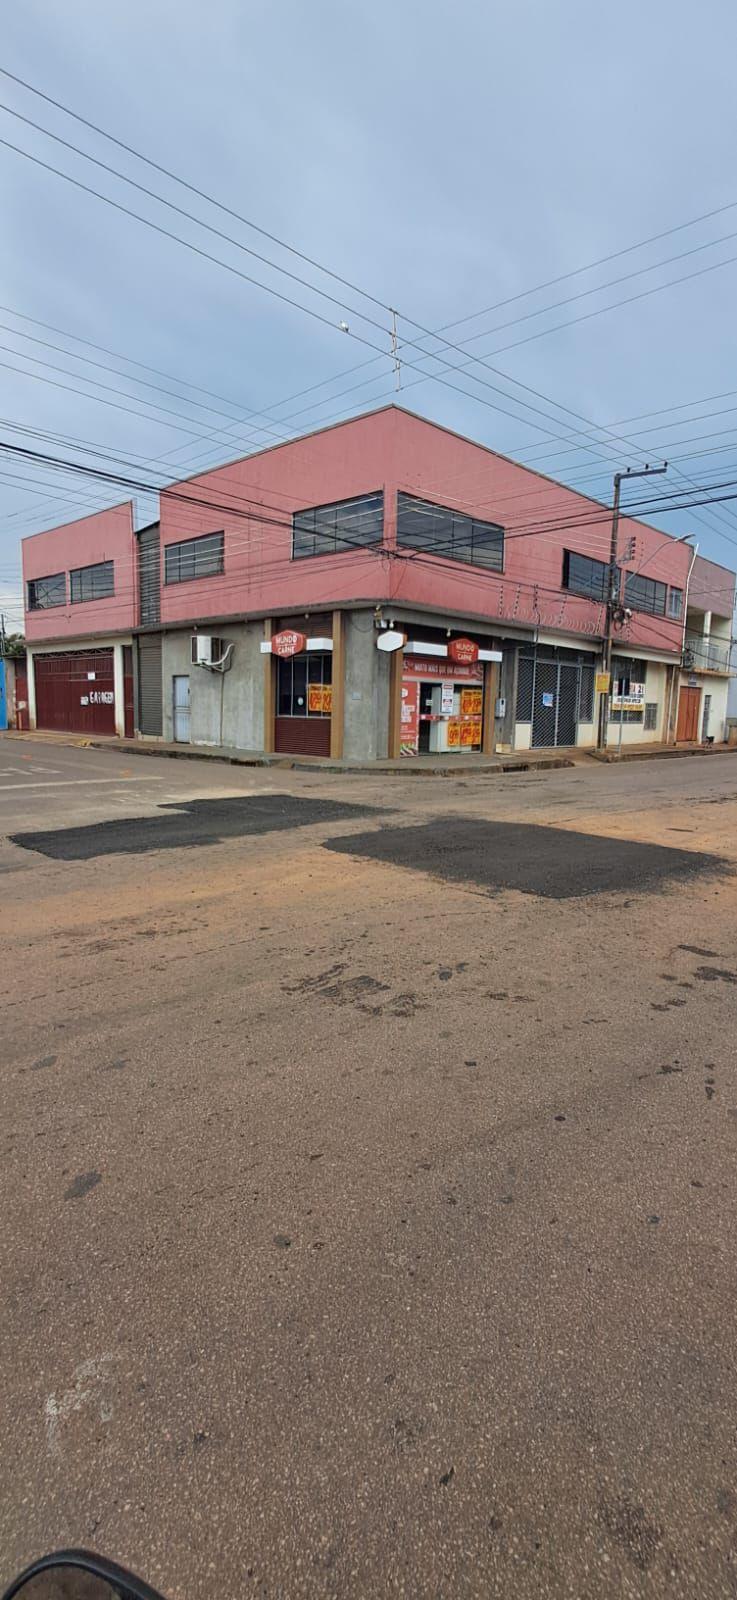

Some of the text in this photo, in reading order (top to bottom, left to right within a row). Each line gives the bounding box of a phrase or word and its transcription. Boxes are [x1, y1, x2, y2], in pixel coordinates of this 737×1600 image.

[275, 634, 298, 644] MUNDO
[277, 646, 295, 655] CARNE
[455, 642, 475, 652] MUNDO
[457, 653, 473, 661] CARNE
